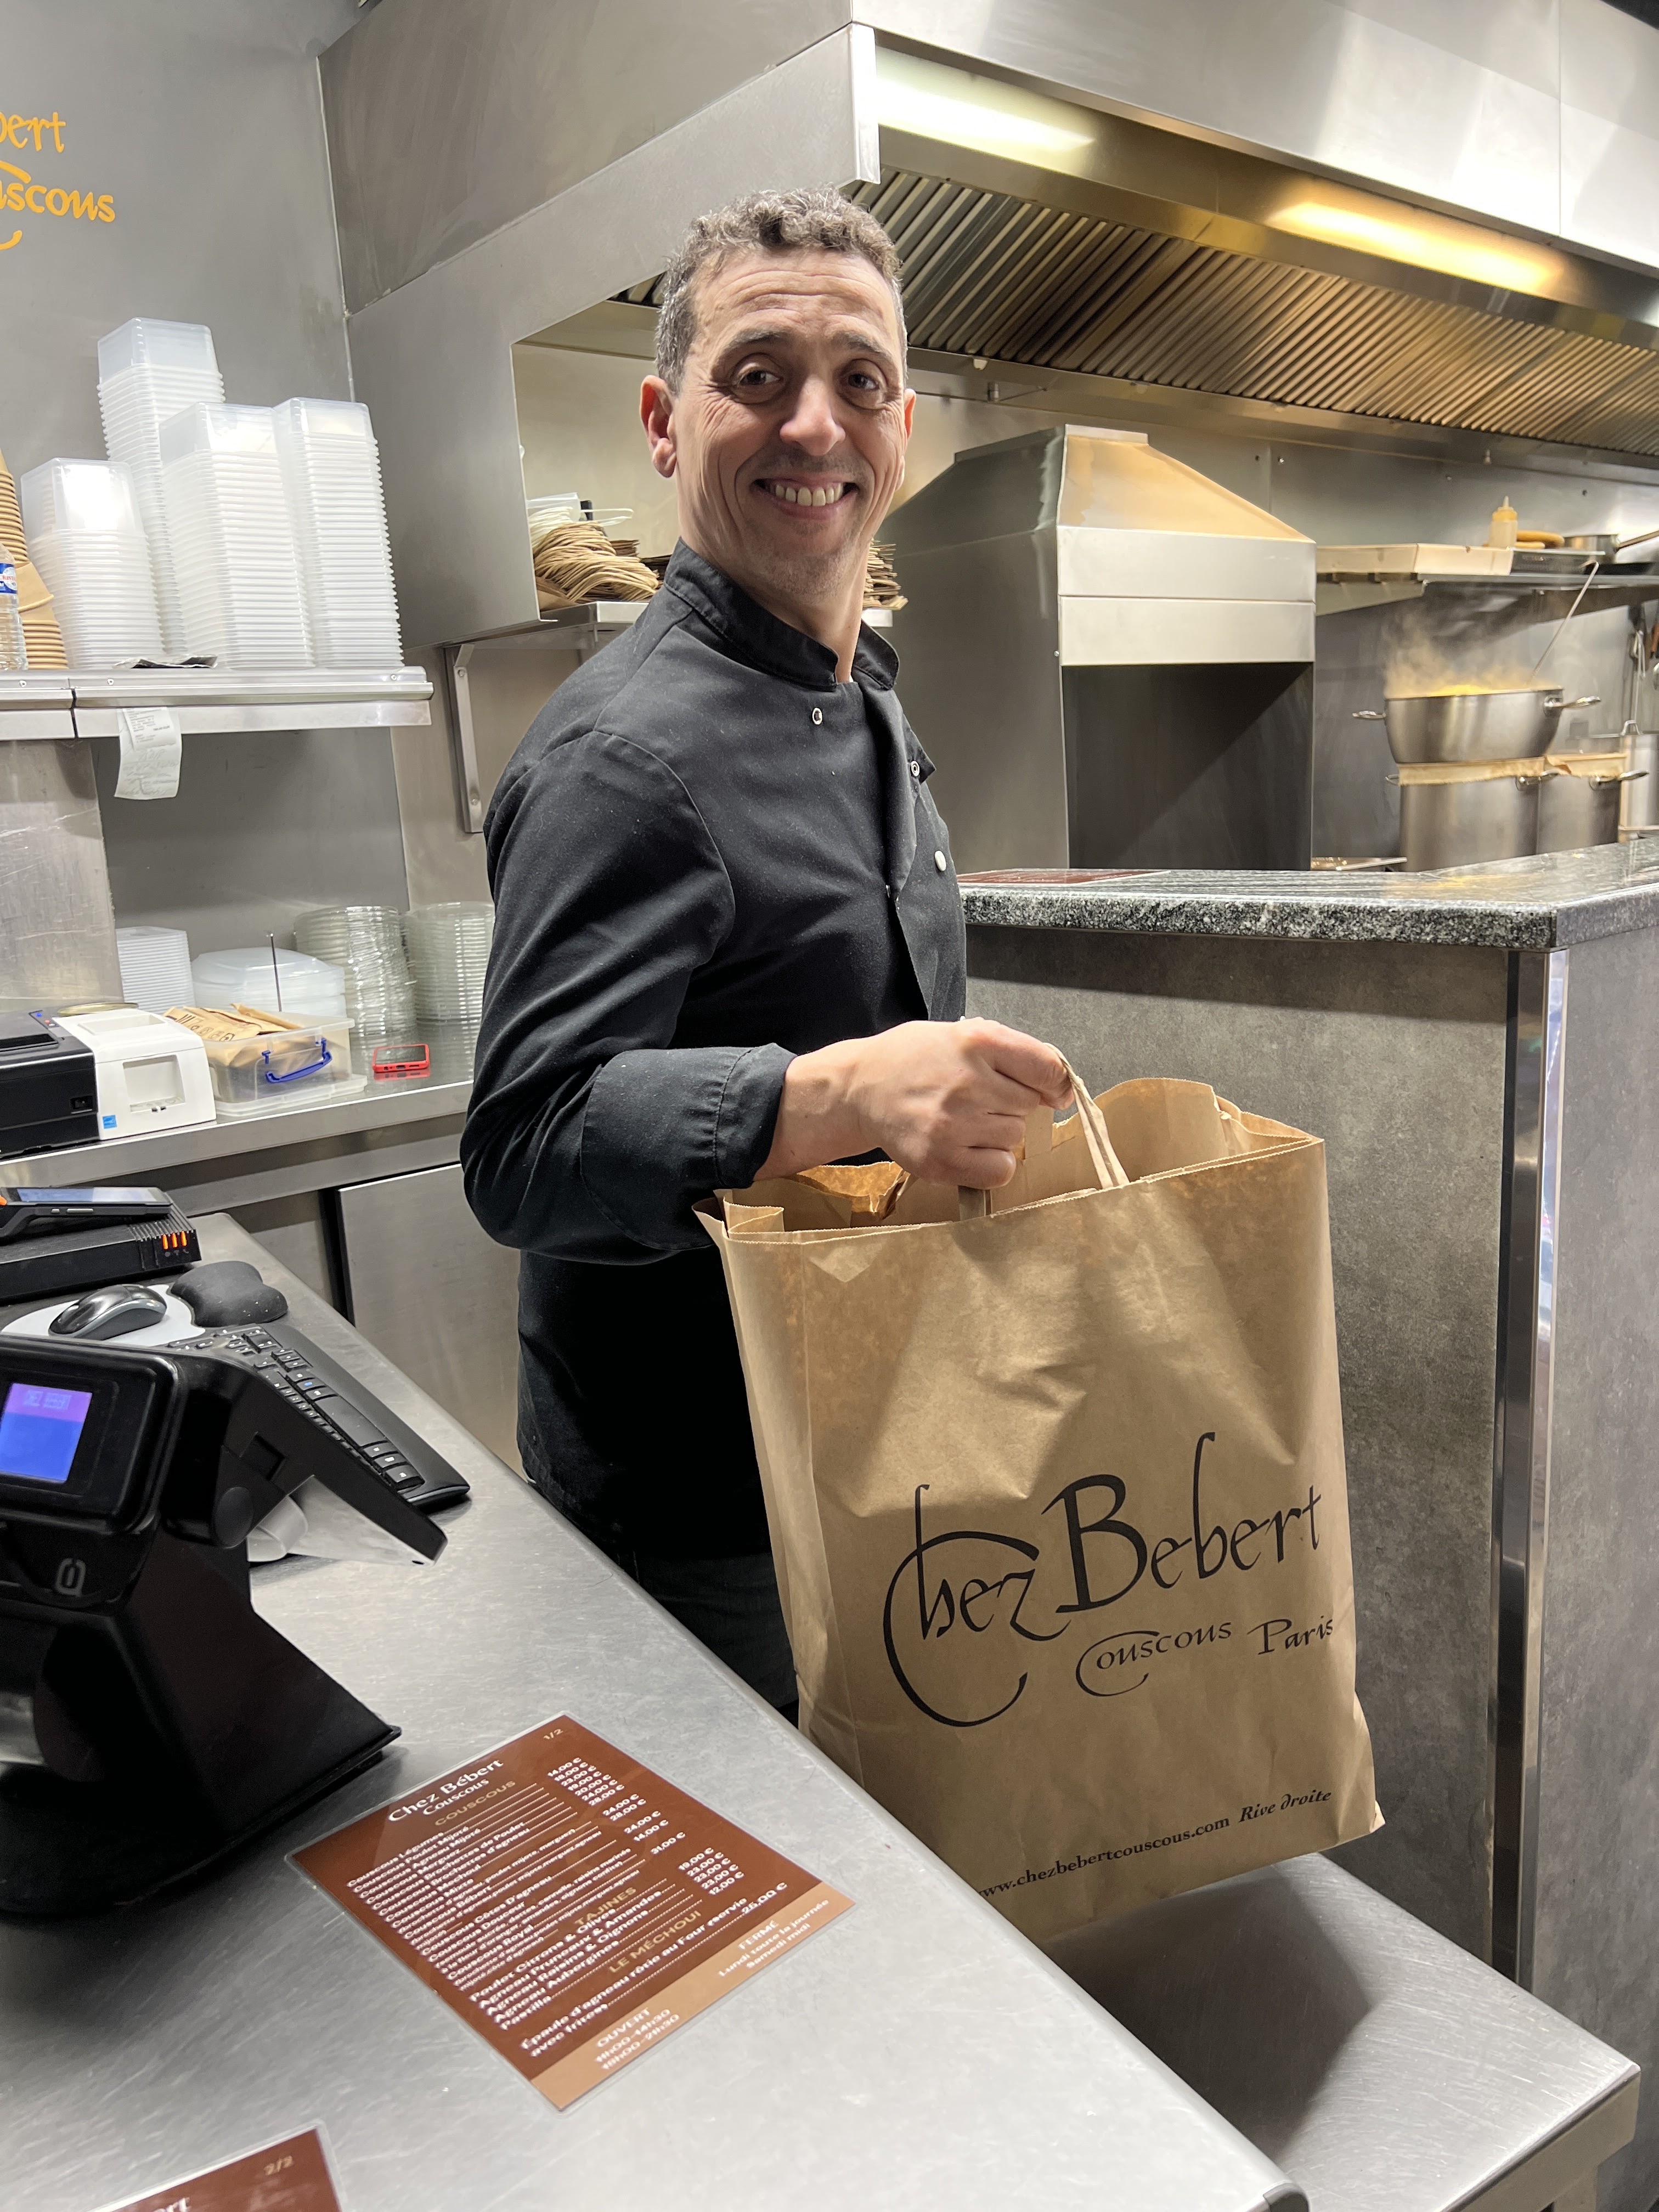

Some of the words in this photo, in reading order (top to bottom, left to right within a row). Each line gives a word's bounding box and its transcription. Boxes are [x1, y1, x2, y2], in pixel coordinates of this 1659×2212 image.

[883, 1484, 1071, 1726] Chez
[1041, 1432, 1321, 1613] Bebert
[1075, 1622, 1231, 1697] Couscous
[1246, 1615, 1333, 1655] Paris
[543, 1729, 563, 1740] 1/2
[388, 1793, 439, 1821] Chez
[440, 1760, 504, 1794] Bébert
[422, 1779, 489, 1815] Couscous
[435, 1781, 516, 1826] COUSCOUS
[602, 1799, 630, 1816] 24,00
[1238, 1803, 1276, 1823] Rive
[1280, 1789, 1332, 1810] droite
[347, 1857, 399, 1887] Couscous
[398, 1832, 444, 1859] Légumes
[548, 1762, 573, 1777] 14,00
[353, 1863, 405, 1893] Couscous
[405, 1844, 438, 1864] Poulet
[437, 1826, 469, 1846] Mijoté
[554, 1767, 579, 1781] 18,00
[359, 1867, 411, 1899] Couscous
[412, 1846, 450, 1869] Agneau
[449, 1828, 481, 1848] Mijoté
[561, 1770, 588, 1787] 23,00
[372, 1879, 424, 1910] Couscous
[424, 1847, 480, 1881] Brochettes
[480, 1839, 494, 1849] de
[574, 1779, 602, 1796] 20,00
[379, 1884, 431, 1916] Couscous
[430, 1853, 487, 1886] Brochettes
[582, 1784, 609, 1801] 24,00
[634, 1825, 660, 1841] 14,00
[366, 1873, 418, 1904] Couscous
[417, 1848, 462, 1875] Merguez
[385, 1890, 437, 1922] Couscous
[589, 1789, 616, 1806] 28,00
[404, 1906, 456, 1939] Couscous
[610, 1804, 637, 1821] 28,00
[421, 1922, 475, 1956] Couscous
[624, 1816, 652, 1834] 24,00
[709, 1877, 735, 1895] 12,00
[392, 1896, 444, 1928] Couscous
[479, 1974, 531, 2009] Agneau
[529, 1934, 591, 1976] Pruneaux
[592, 1928, 603, 1937] &
[605, 1891, 662, 1929] Amandes
[687, 1858, 715, 1877] 23,00
[574, 1887, 636, 1925] TAJINES
[428, 1928, 482, 1962] Couscous
[447, 1944, 503, 1980] Couscous
[502, 1924, 535, 1946] Royal
[469, 1971, 515, 2002] Poulet
[515, 1941, 564, 1973] Citrons
[564, 1934, 576, 1942] &
[576, 1909, 616, 1934] Olives
[486, 1980, 538, 2016] Agneau
[537, 1951, 584, 1982] Raisins
[585, 1943, 597, 1952] &
[597, 1910, 648, 1943] Oignons
[693, 1864, 722, 1883] 23,00
[494, 1987, 546, 2023] Agneau
[547, 1940, 619, 1989] Aubergines
[701, 1870, 730, 1889] 23,00
[608, 1957, 629, 1973] LE
[630, 1910, 701, 1959] MÉCHOUI
[662, 1943, 679, 1956] au
[676, 1924, 706, 1945] Four
[531, 2032, 565, 2057] avec
[596, 2009, 650, 2047] OUVERT
